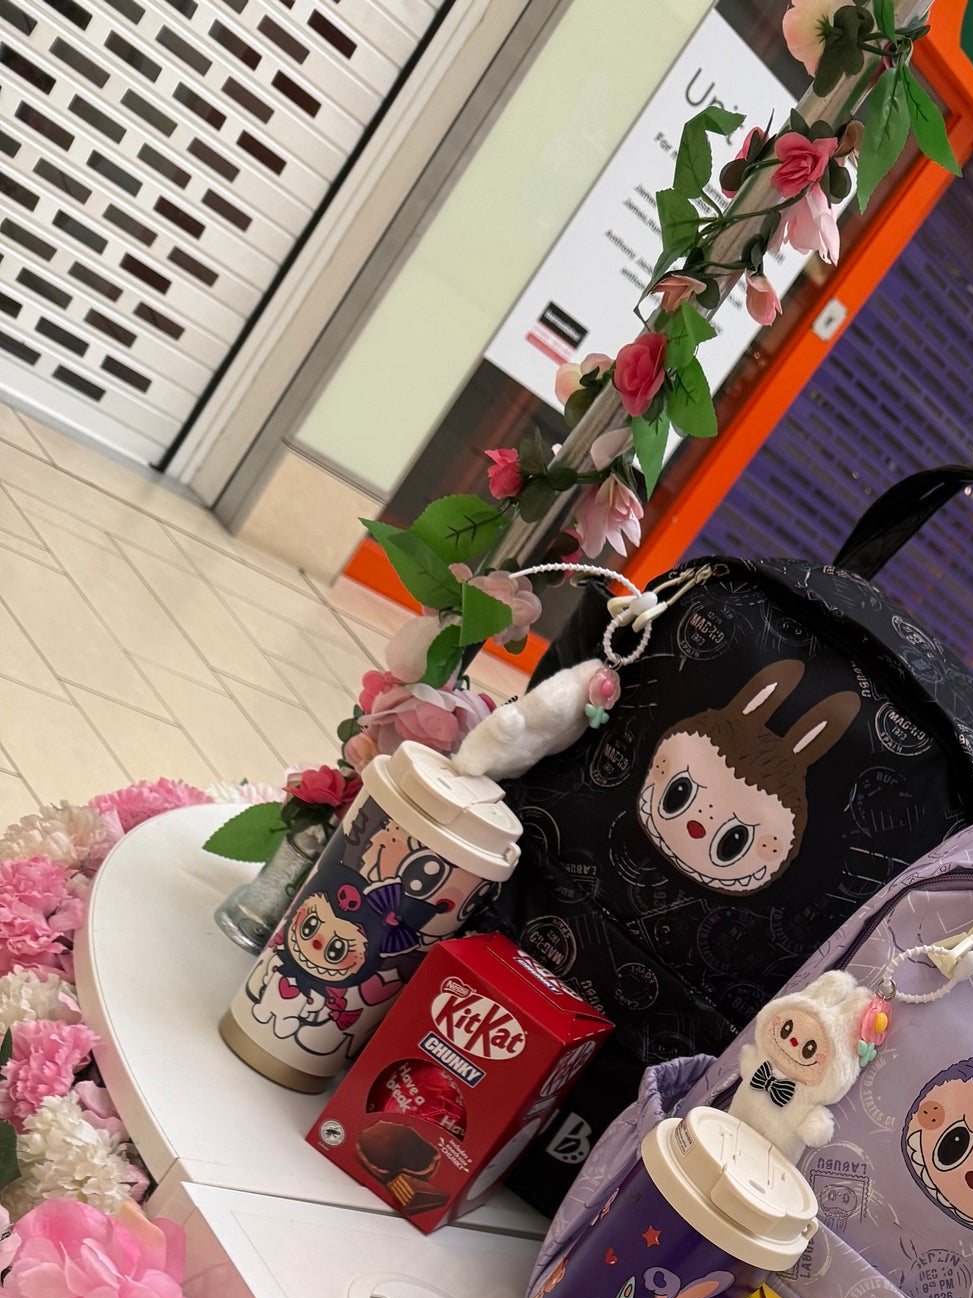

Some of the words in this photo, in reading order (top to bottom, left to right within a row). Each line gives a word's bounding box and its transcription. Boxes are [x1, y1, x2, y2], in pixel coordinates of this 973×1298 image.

[434, 996, 526, 1058] KitKat
[398, 1062, 419, 1096] Have
[415, 1095, 425, 1106] a
[422, 1035, 483, 1084] CHUNKY
